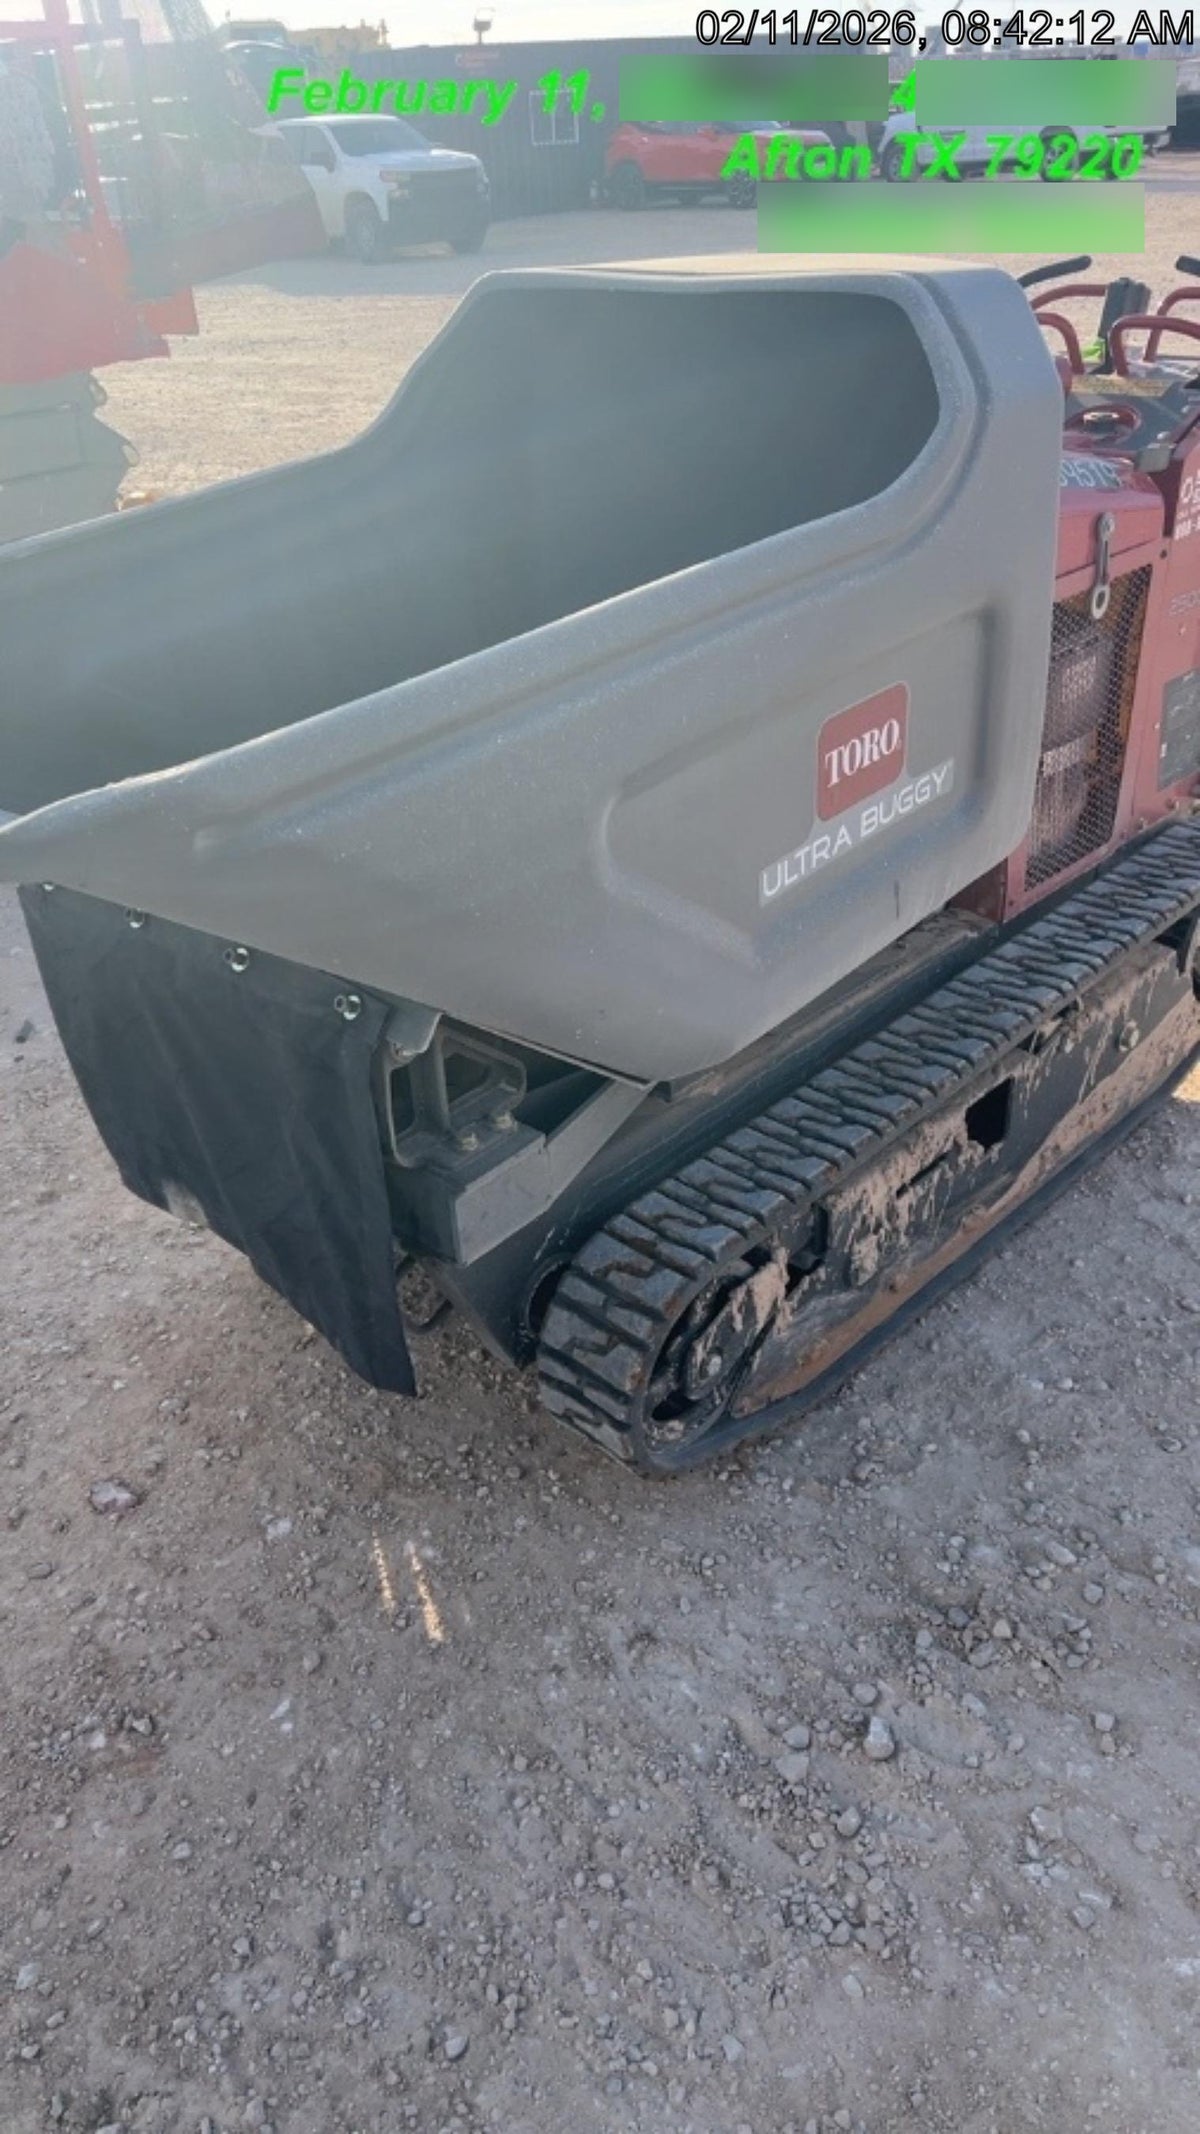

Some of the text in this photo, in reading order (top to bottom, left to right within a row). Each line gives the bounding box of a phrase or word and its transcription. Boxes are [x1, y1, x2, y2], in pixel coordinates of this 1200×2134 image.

[824, 718, 901, 788] TORO
[760, 763, 950, 898] ULTRA BUGGY
